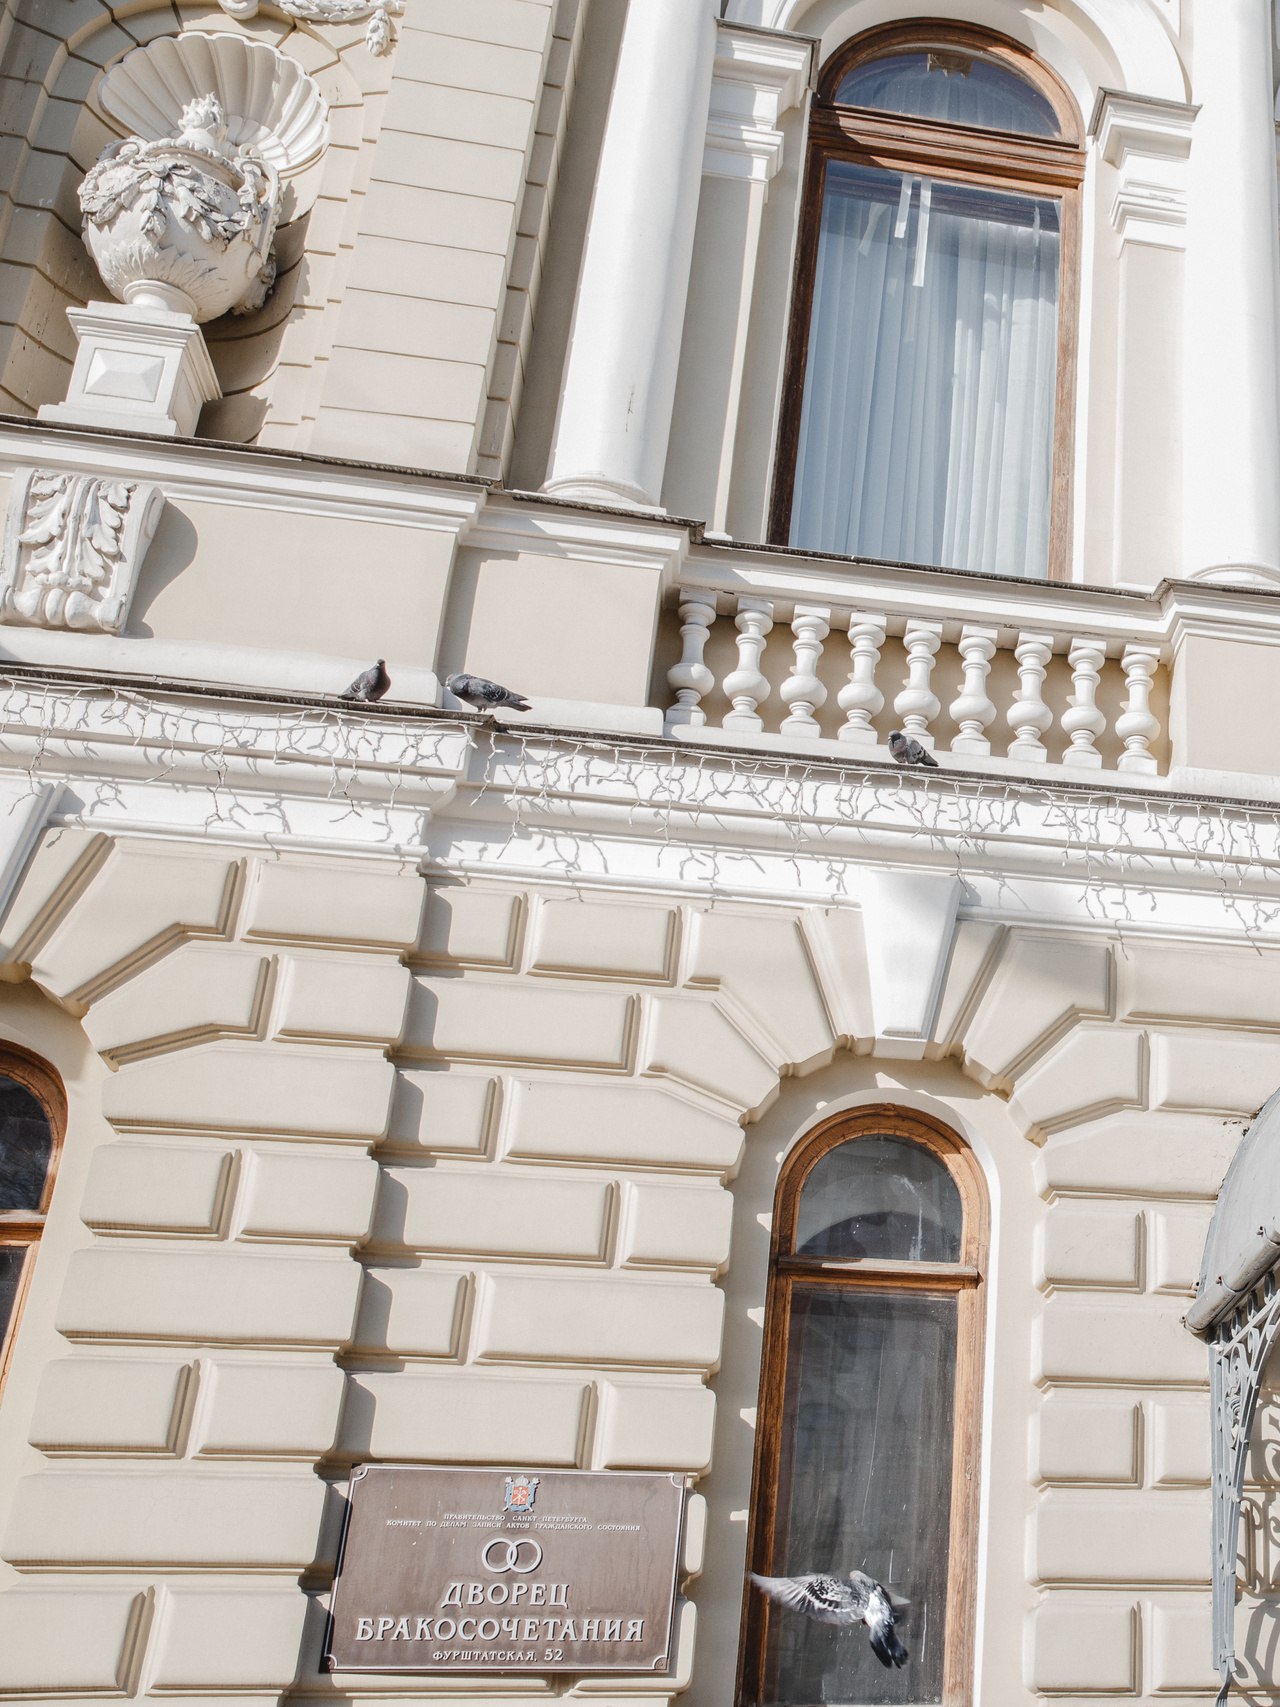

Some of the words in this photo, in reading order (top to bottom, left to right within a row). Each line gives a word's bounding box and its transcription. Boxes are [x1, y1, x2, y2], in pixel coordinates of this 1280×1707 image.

[443, 1513, 506, 1521] ПРАВИТЕЛЬСТВО
[441, 1582, 569, 1608] ДВОРЕЦ
[355, 1617, 644, 1642] БРАКОСОЧЕТАНИЯ
[432, 1650, 538, 1662] ФУРШТАТСКАЯ,
[544, 1649, 563, 1661] 52
